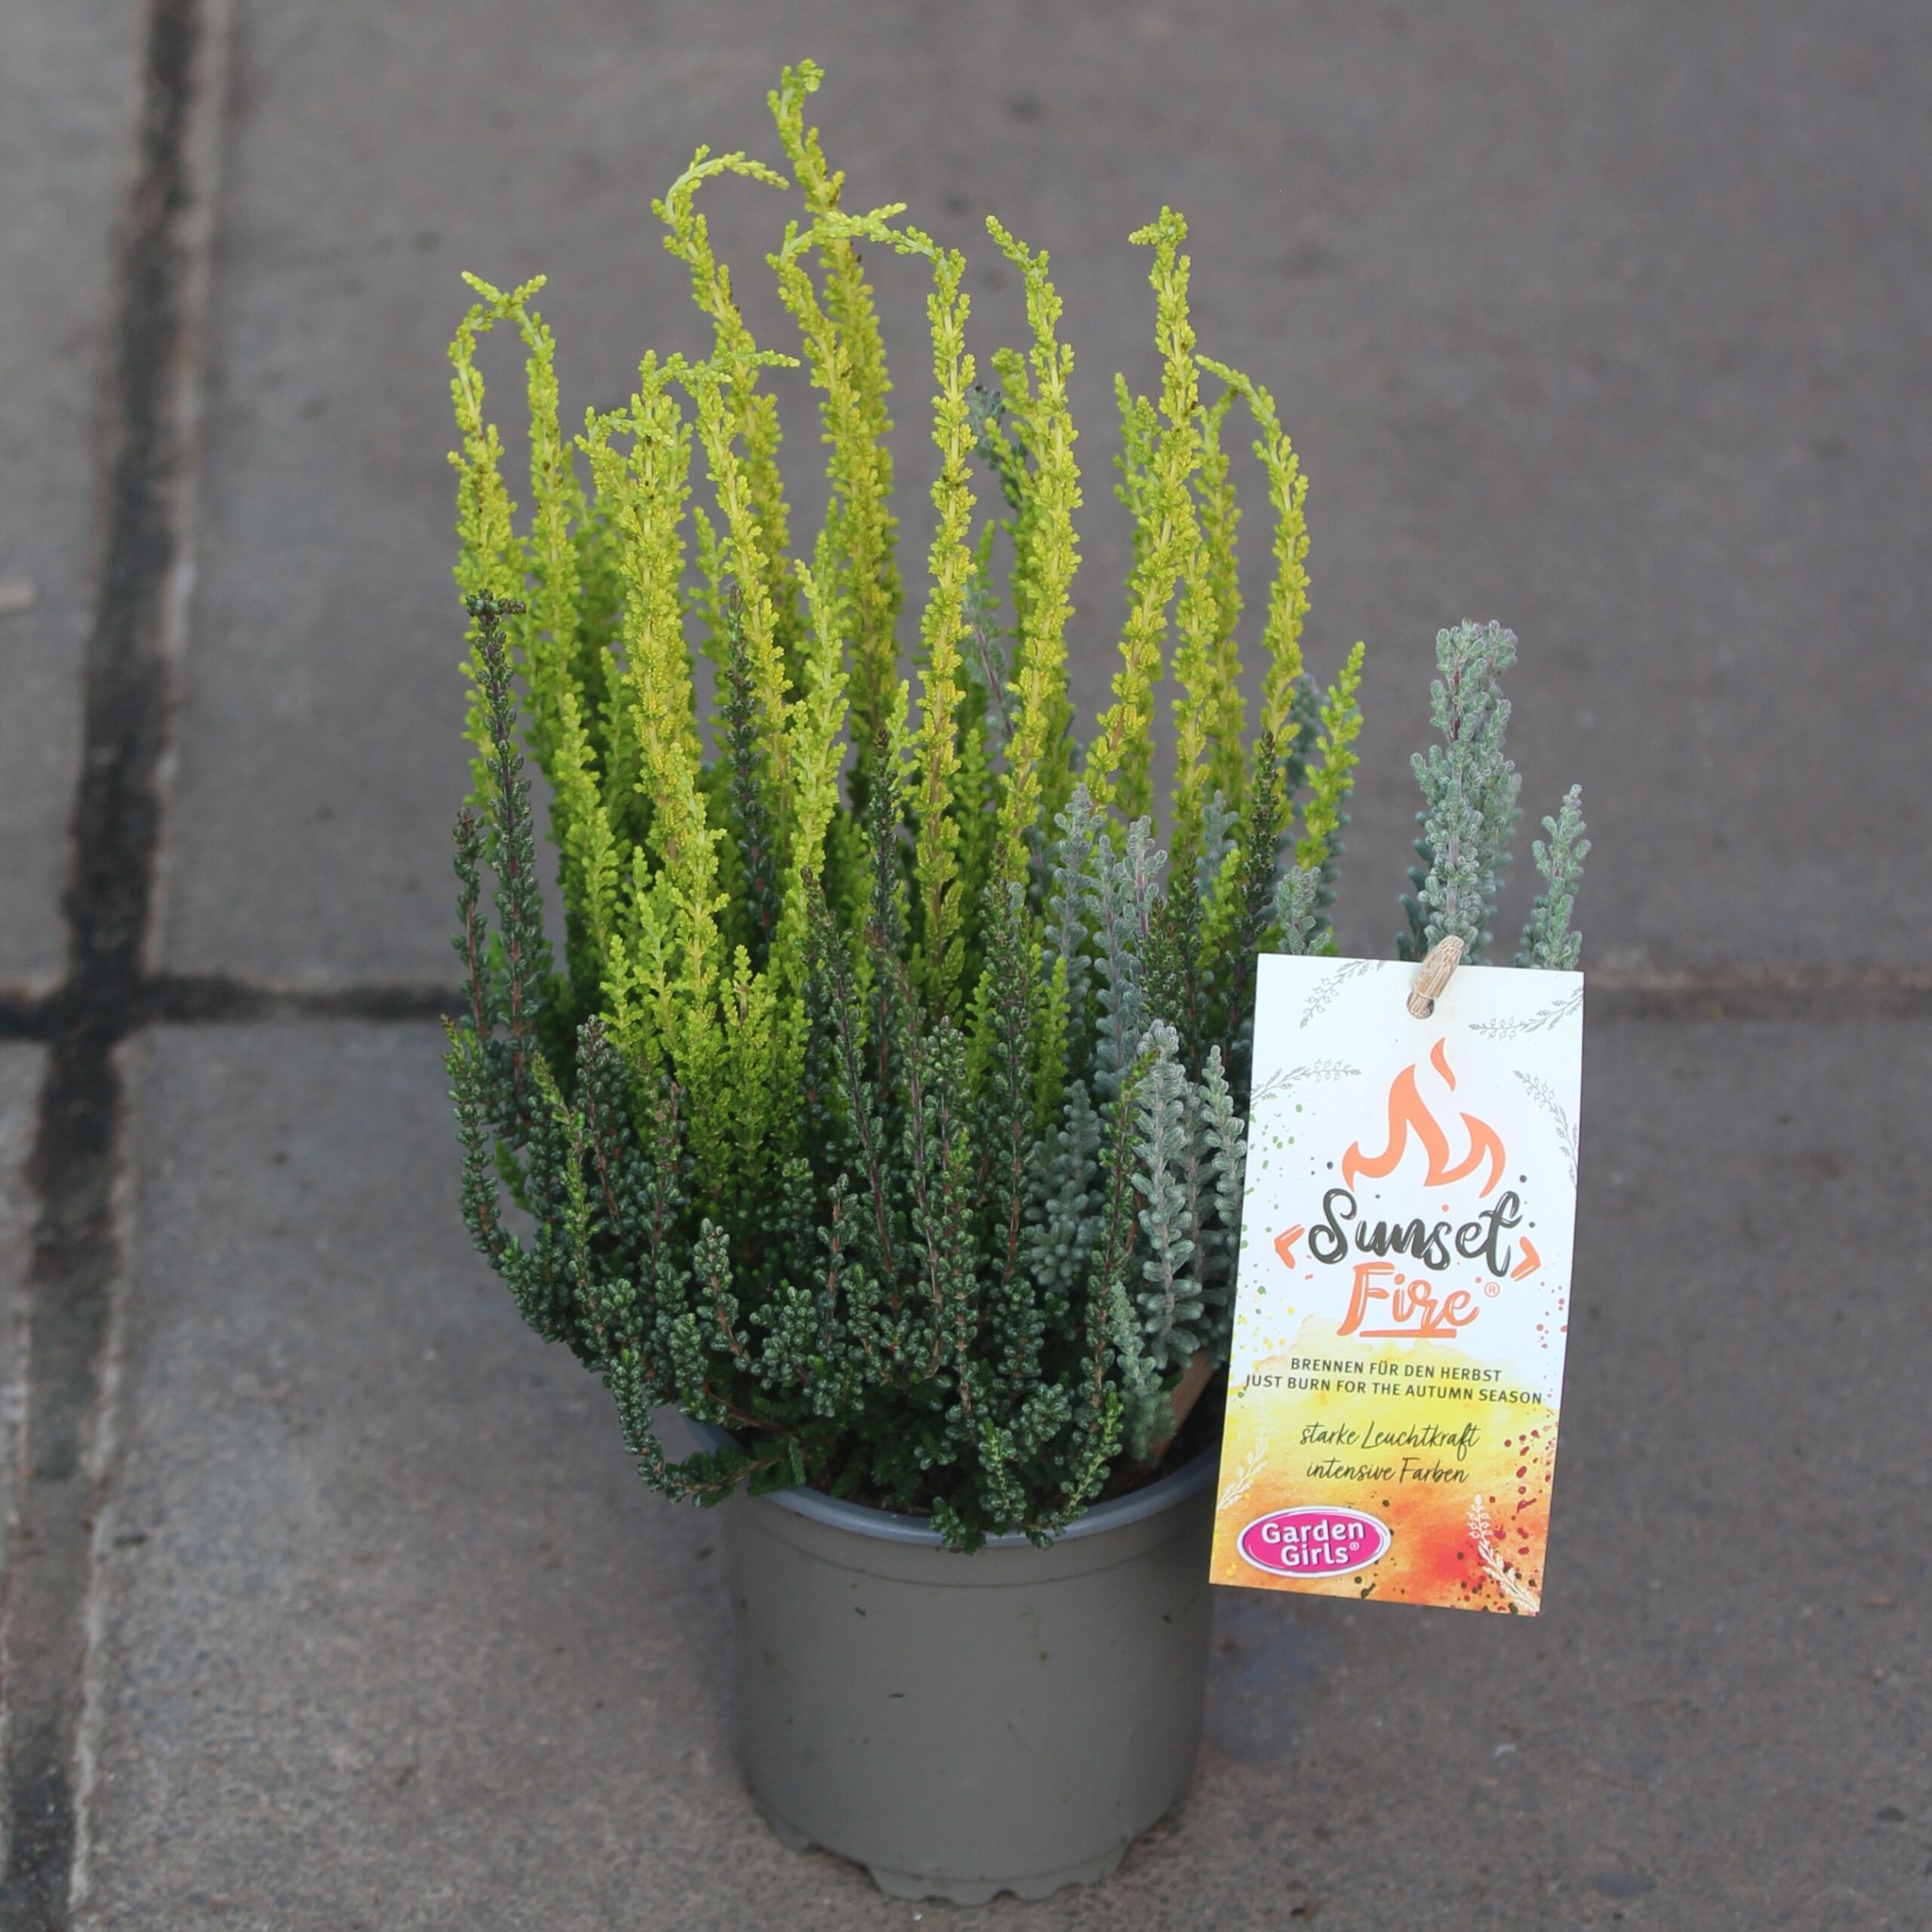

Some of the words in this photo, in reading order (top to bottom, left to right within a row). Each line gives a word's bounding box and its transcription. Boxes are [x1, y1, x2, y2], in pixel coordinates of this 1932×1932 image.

[1309, 1188, 1523, 1277] Sunset
[1291, 1358, 1363, 1374] BRENNEN
[1369, 1360, 1398, 1377] FÜR
[1404, 1365, 1435, 1379] DEN
[1441, 1367, 1502, 1382] HERBST
[1244, 1374, 1282, 1389] JUST
[1287, 1377, 1331, 1391] BURN
[1337, 1380, 1366, 1393] FOR
[1373, 1382, 1401, 1395] THE
[1405, 1384, 1473, 1401] AUTUMN
[1478, 1389, 1542, 1404] SEASON
[1300, 1422, 1359, 1446] starke
[1361, 1421, 1481, 1461] Leuchtkraft
[1306, 1457, 1395, 1481] intensive
[1400, 1457, 1469, 1484] Farben
[1261, 1518, 1364, 1544] Garden
